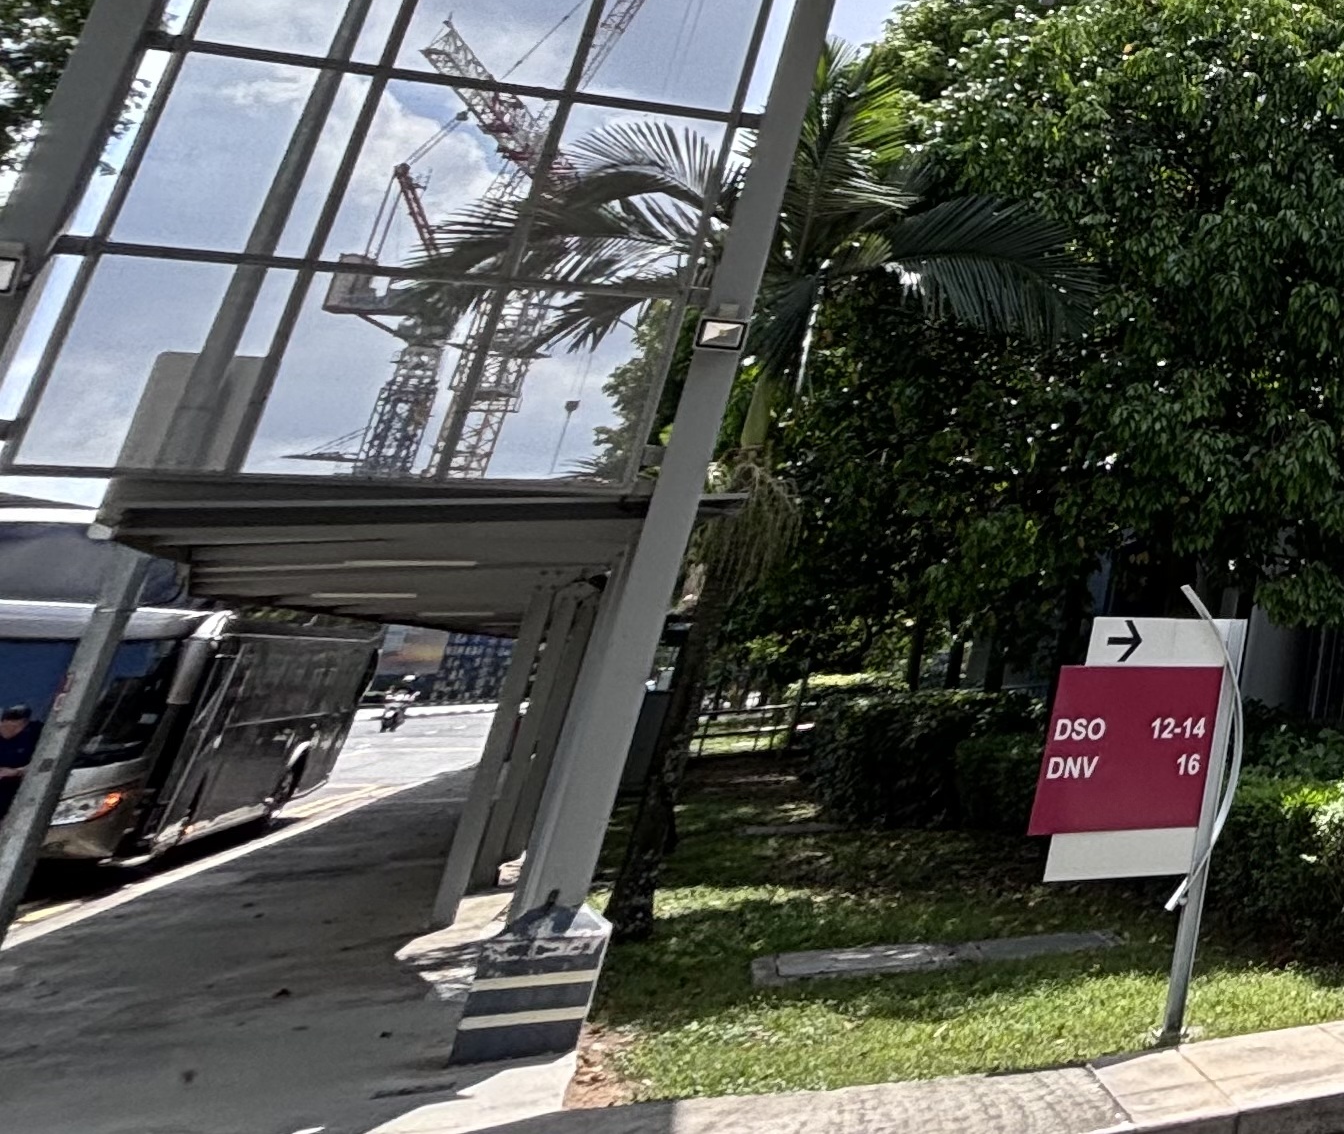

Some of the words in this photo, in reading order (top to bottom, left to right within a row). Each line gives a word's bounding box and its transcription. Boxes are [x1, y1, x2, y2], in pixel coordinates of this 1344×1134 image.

[1053, 718, 1106, 741] DSO
[1151, 717, 1206, 739] 12-14
[1046, 756, 1100, 779] DNV
[1176, 754, 1201, 776] 16
